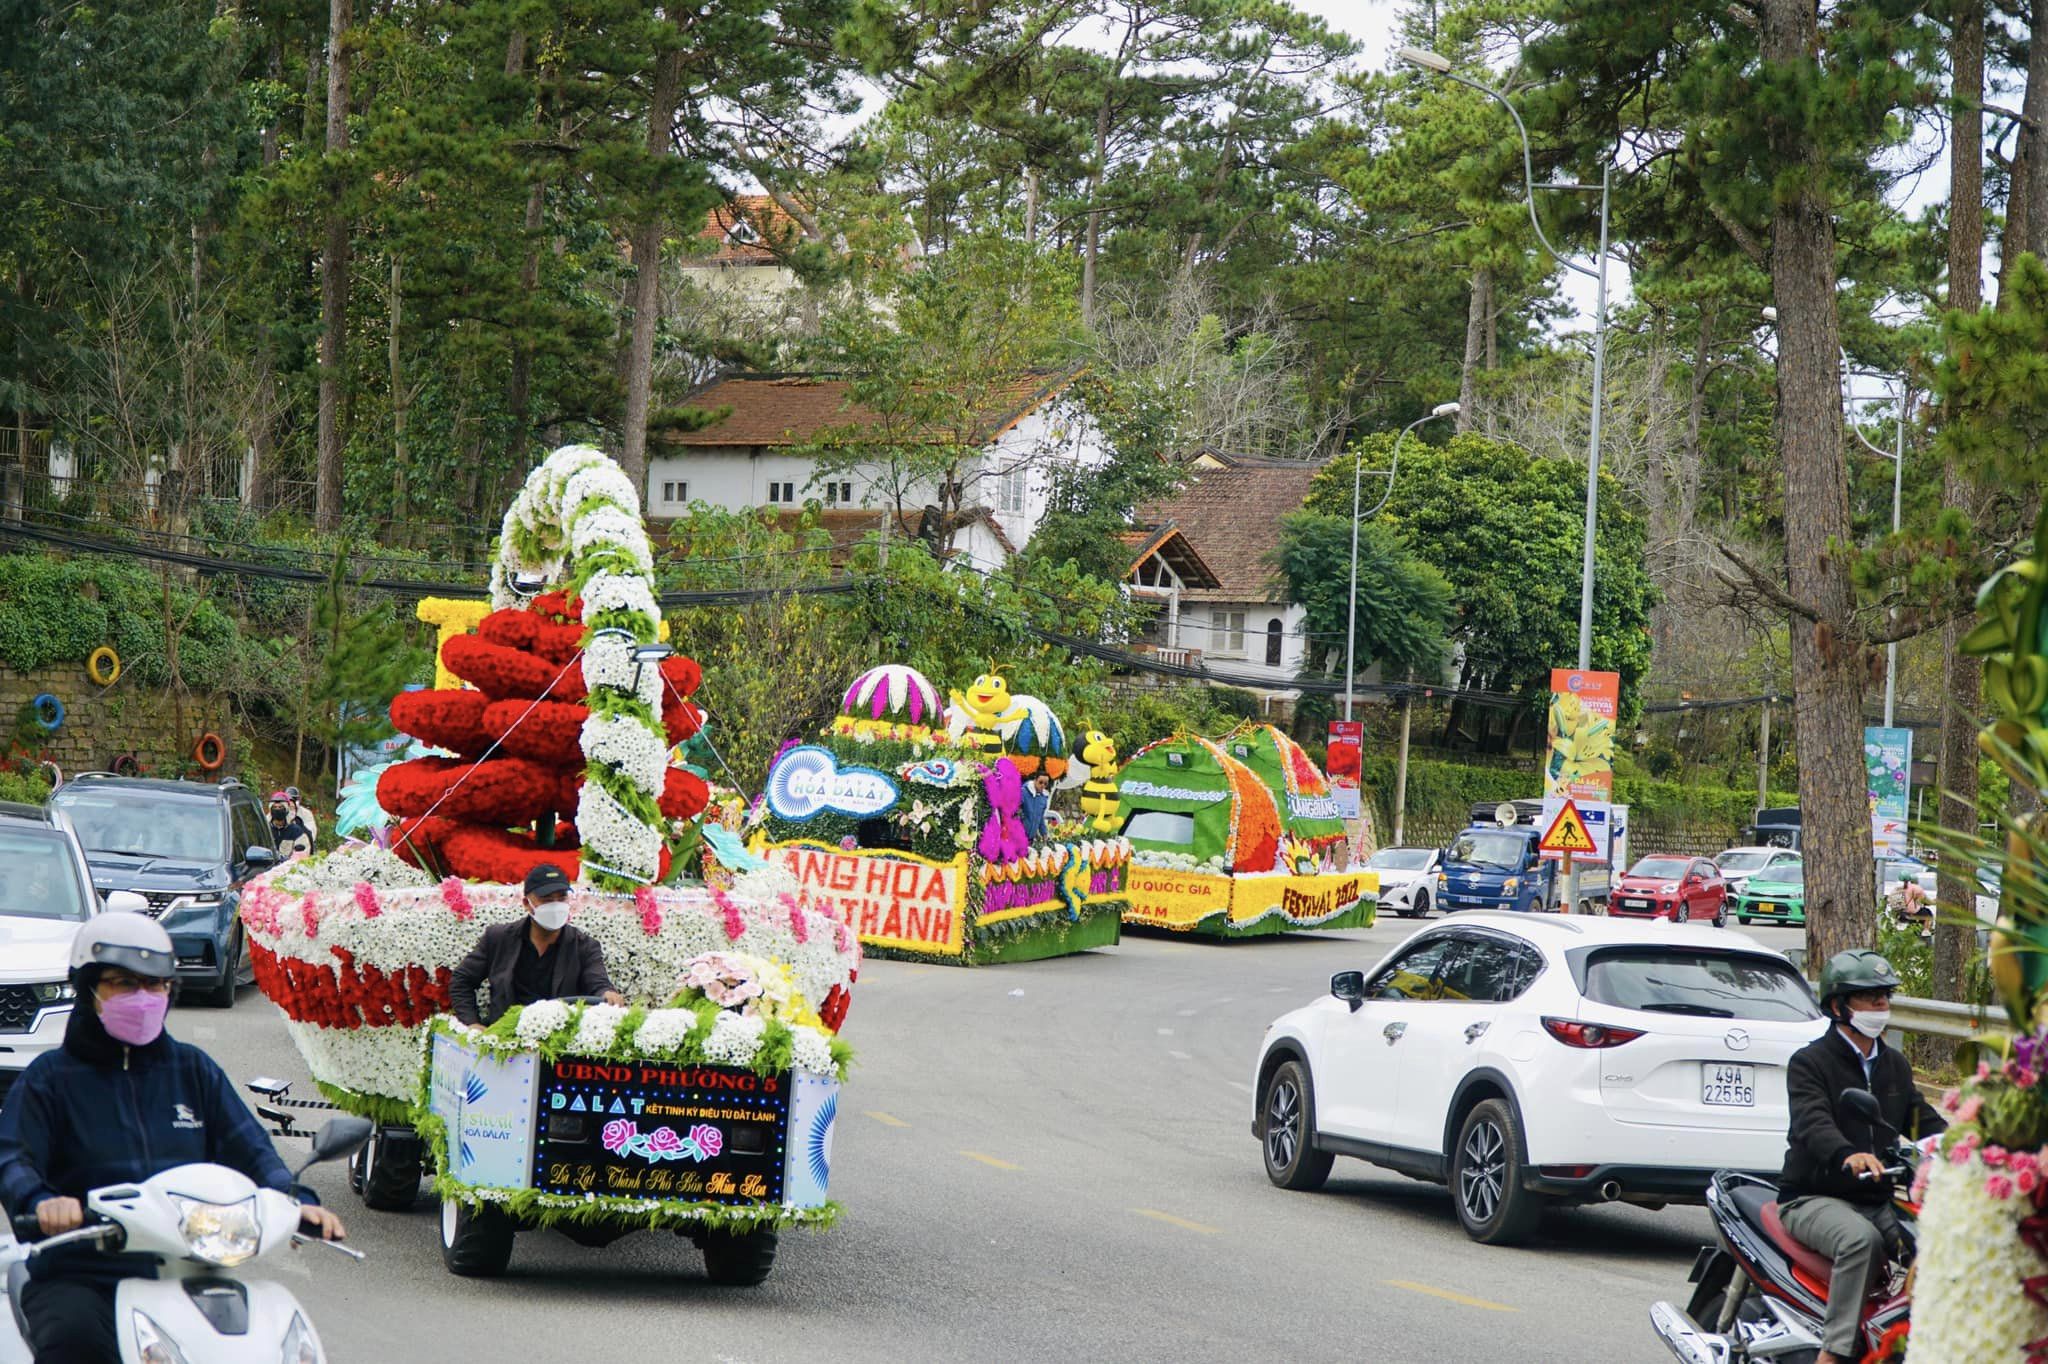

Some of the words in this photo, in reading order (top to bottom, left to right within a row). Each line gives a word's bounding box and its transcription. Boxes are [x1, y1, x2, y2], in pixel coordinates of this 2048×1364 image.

[866, 859, 947, 904] HOA
[1189, 884, 1212, 896] GIA
[1282, 886, 1332, 918] FESTIVAL
[555, 1063, 633, 1082] UBND
[641, 1067, 756, 1092] PHƯỜNG
[763, 1078, 778, 1093] 5
[1716, 1066, 1743, 1084] 49A
[551, 1093, 646, 1115] DALAT
[1704, 1085, 1752, 1104] 225.56
[665, 1106, 685, 1116] TINH
[752, 1110, 776, 1122] LÀNH
[605, 1165, 646, 1189] Thành
[645, 1168, 676, 1191] Phố
[705, 1172, 737, 1195] Mùa
[739, 1174, 768, 1198] Hoa
